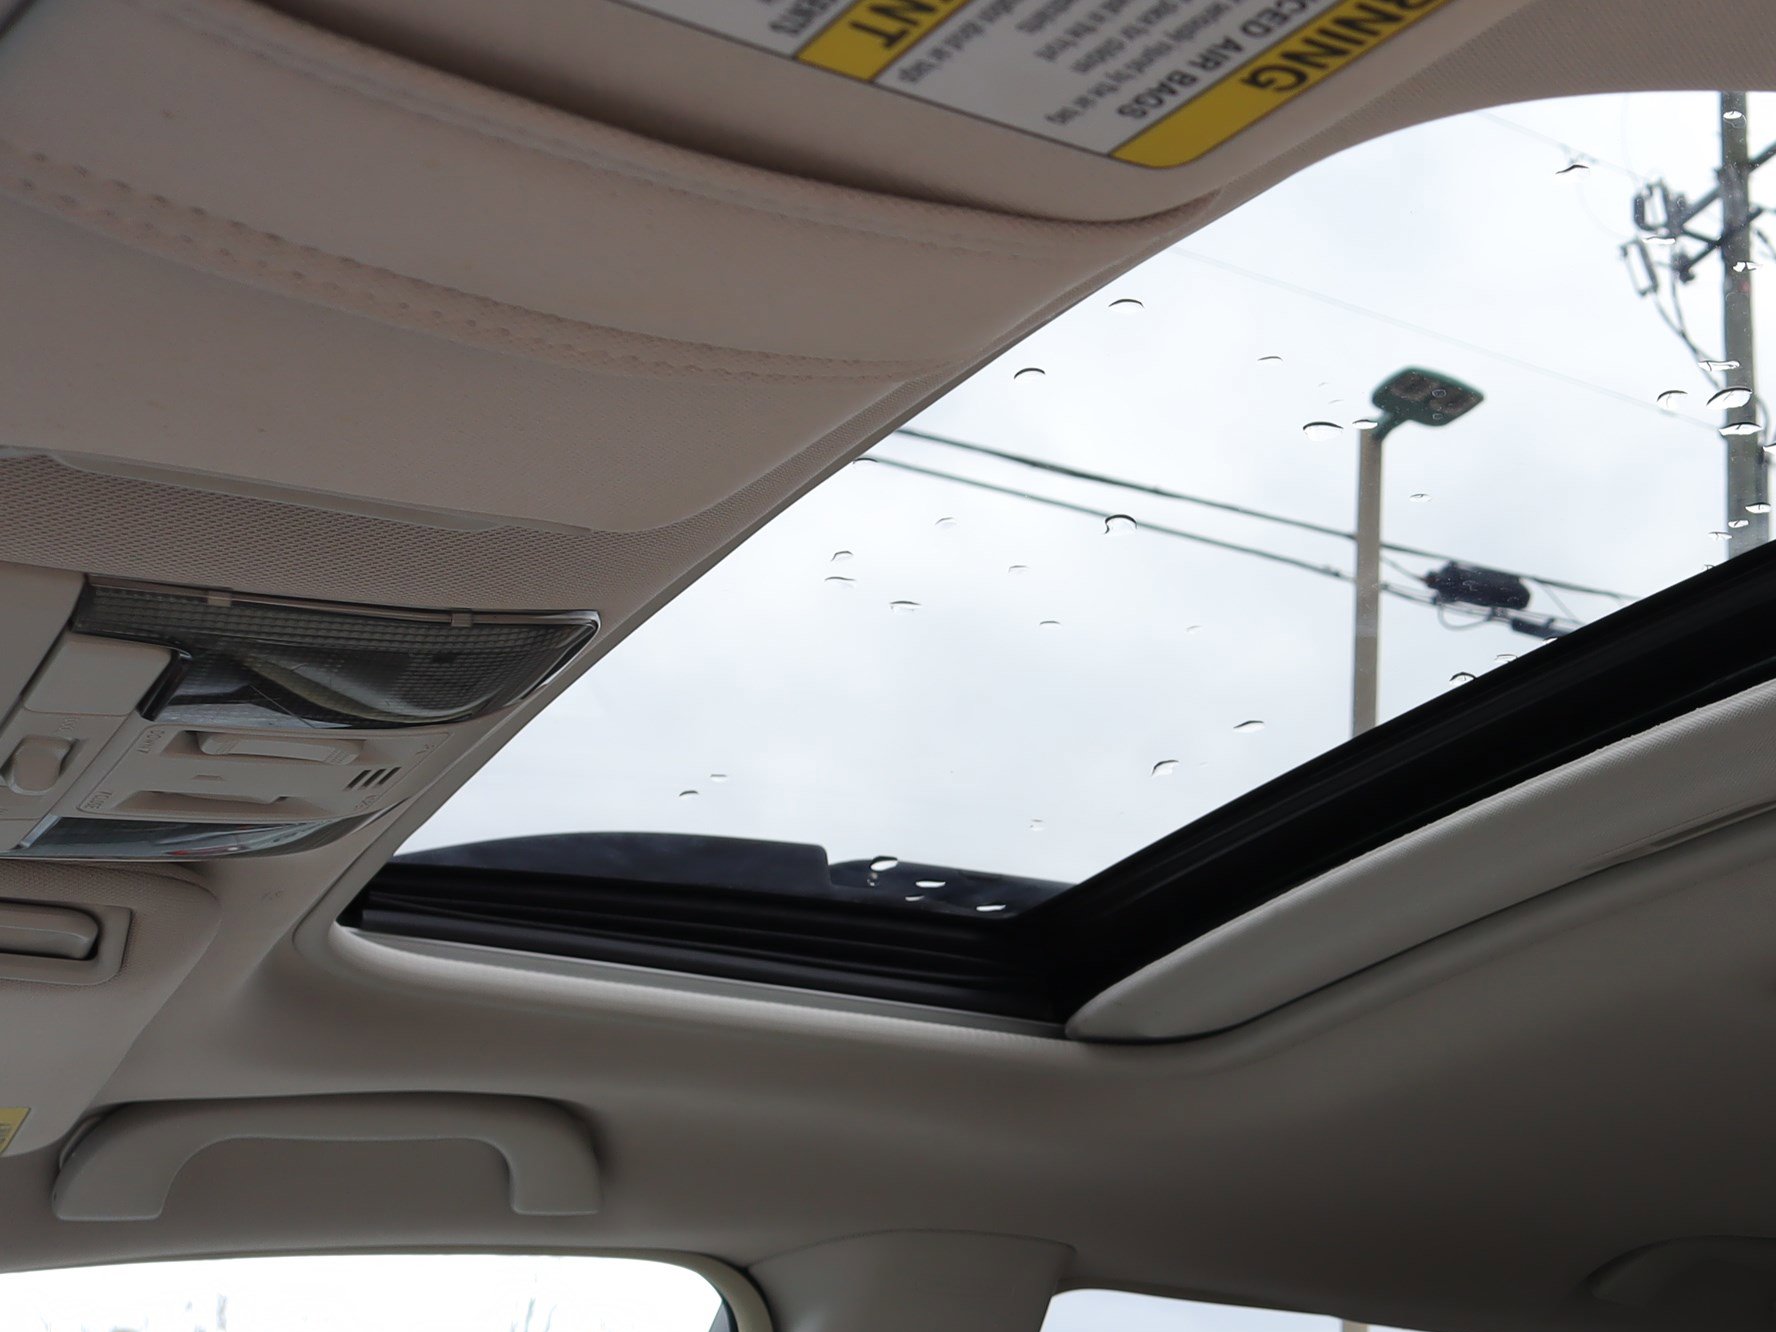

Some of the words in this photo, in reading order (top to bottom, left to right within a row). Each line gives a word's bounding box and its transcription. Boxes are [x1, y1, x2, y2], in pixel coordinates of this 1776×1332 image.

[849, 0, 946, 49] NT
[1189, 35, 1243, 72] AIR
[1117, 69, 1198, 120] BAGS
